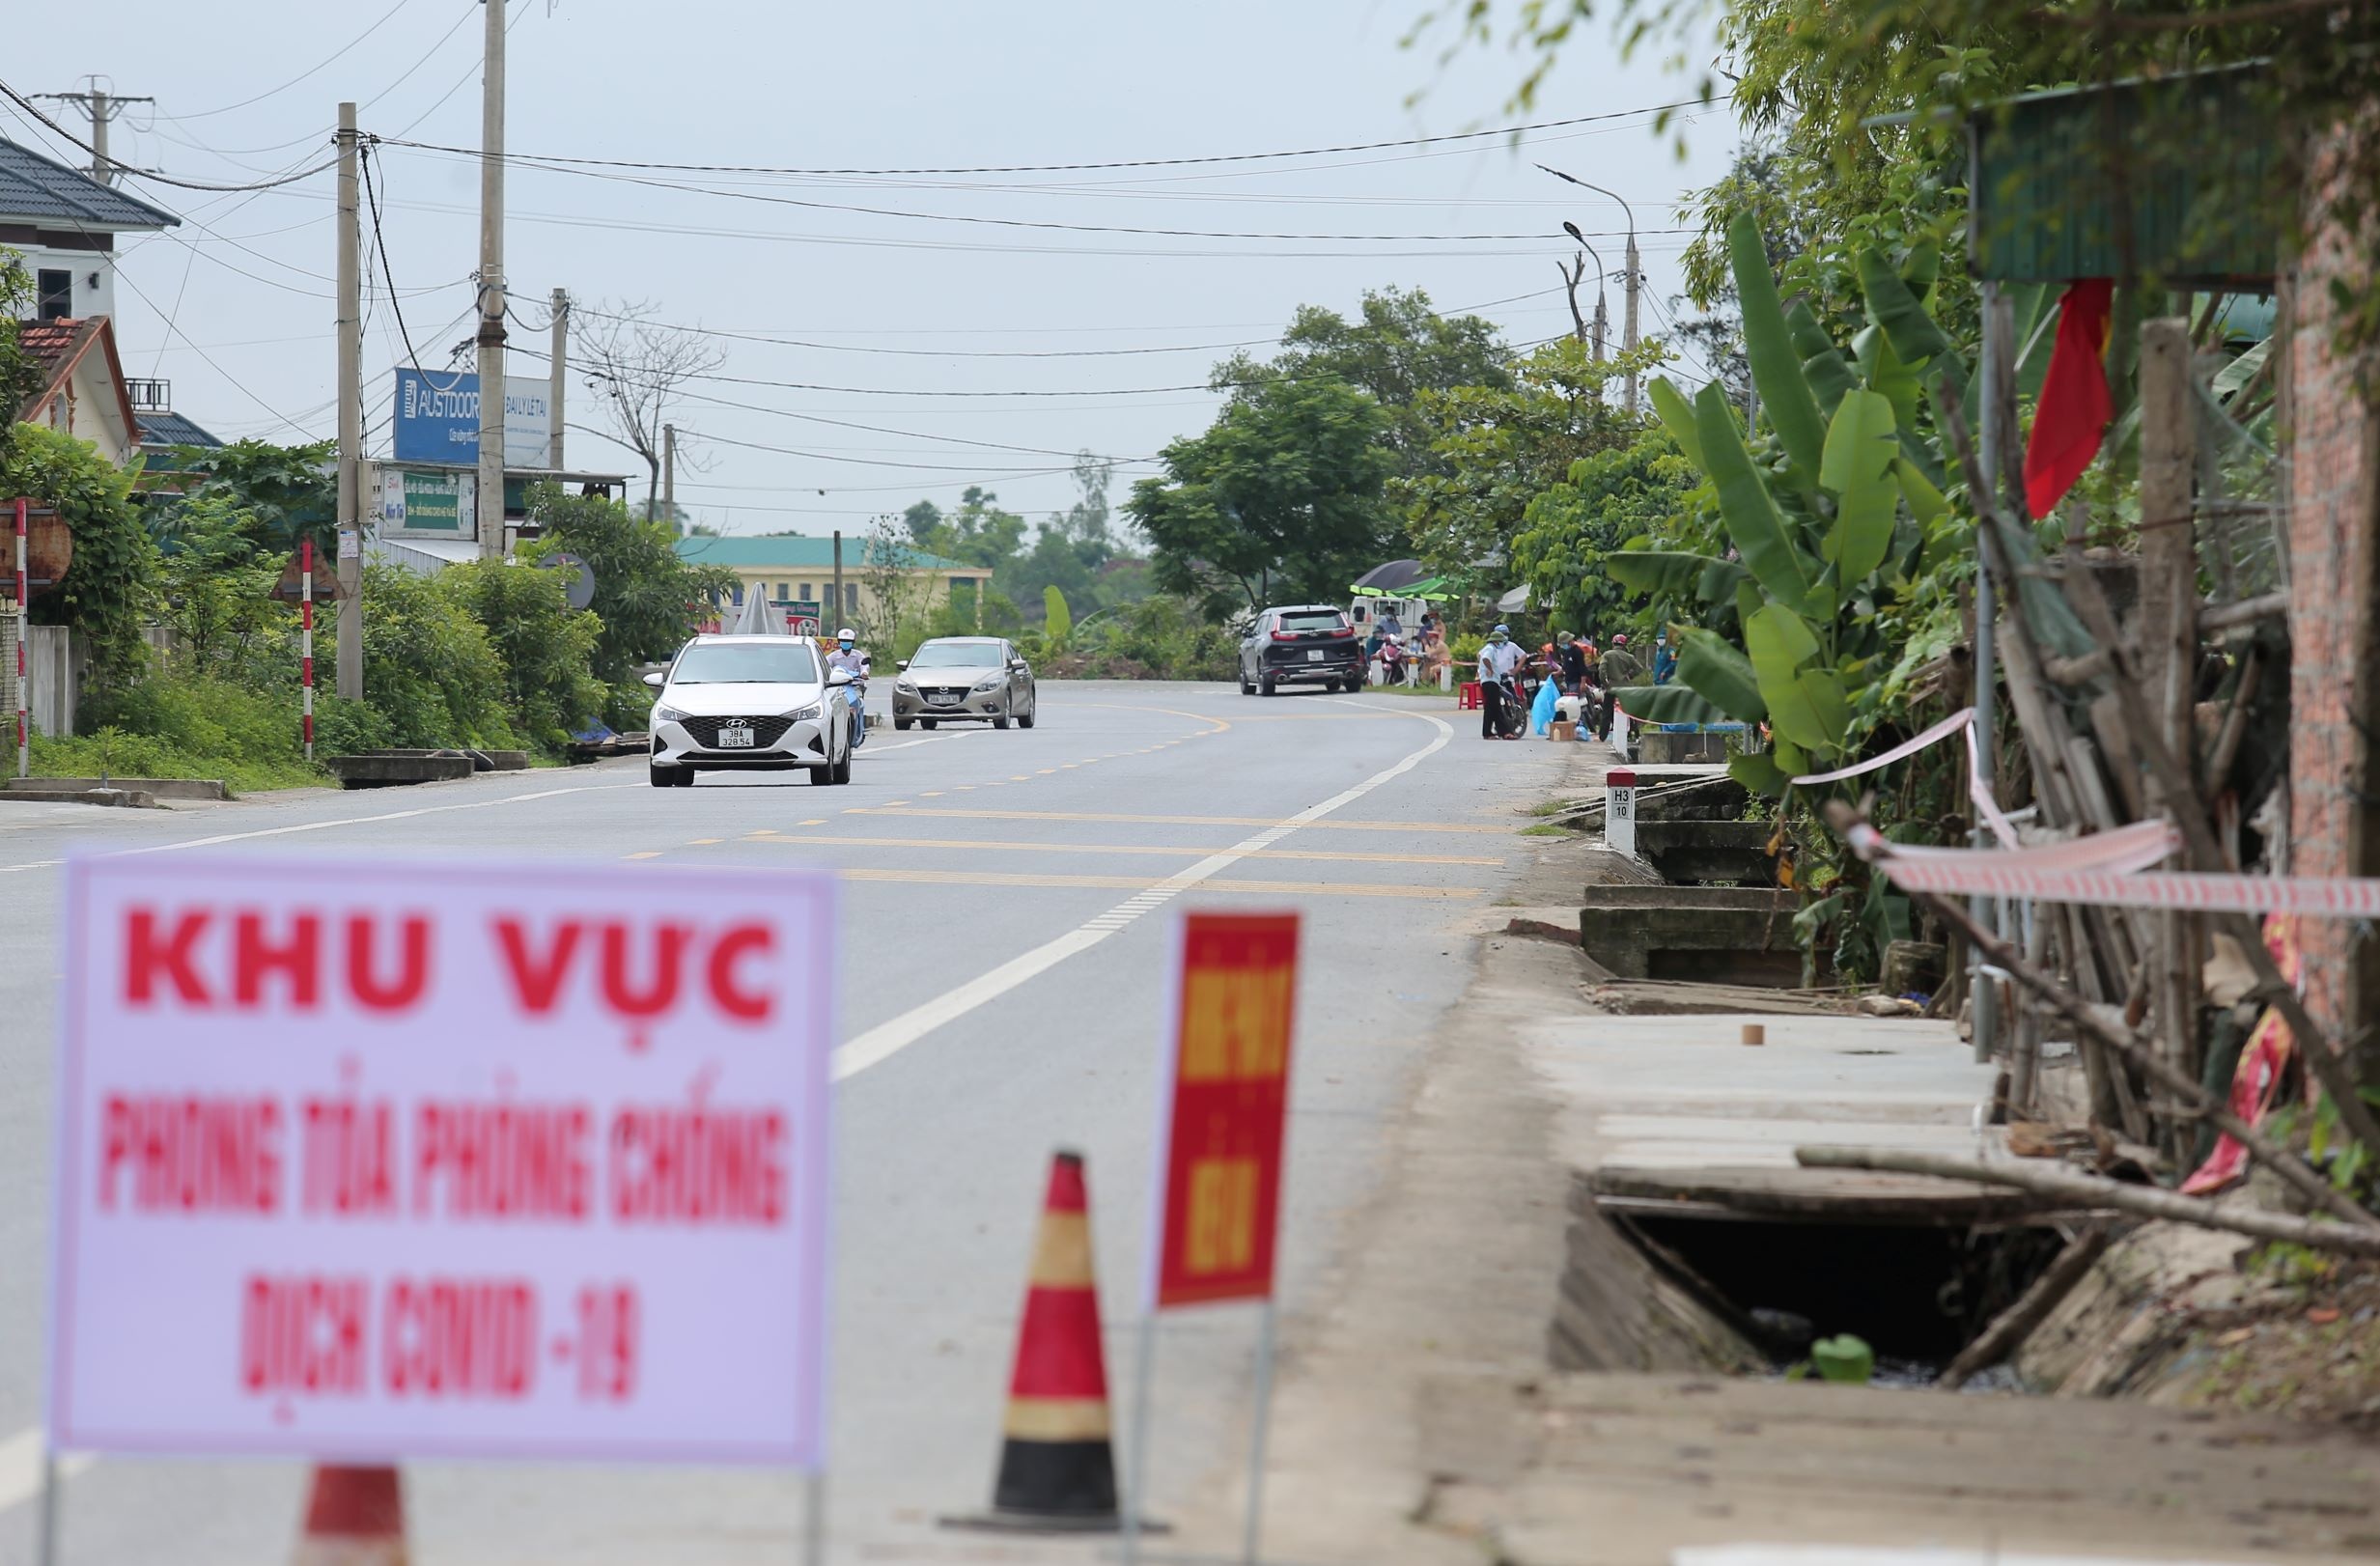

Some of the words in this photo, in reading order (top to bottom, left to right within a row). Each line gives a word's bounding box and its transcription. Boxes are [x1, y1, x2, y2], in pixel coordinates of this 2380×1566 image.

[418, 389, 480, 419] AUSTDOOR
[722, 738, 750, 746] 328.54
[1614, 790, 1629, 801] H3
[1616, 806, 1627, 816] 10
[122, 905, 433, 1016] KHU
[490, 913, 778, 1049] VỰC
[100, 1092, 282, 1215] PHONG
[610, 1062, 786, 1227] CHỐNG
[241, 1275, 368, 1425] DỊCH
[383, 1277, 535, 1399] COVID
